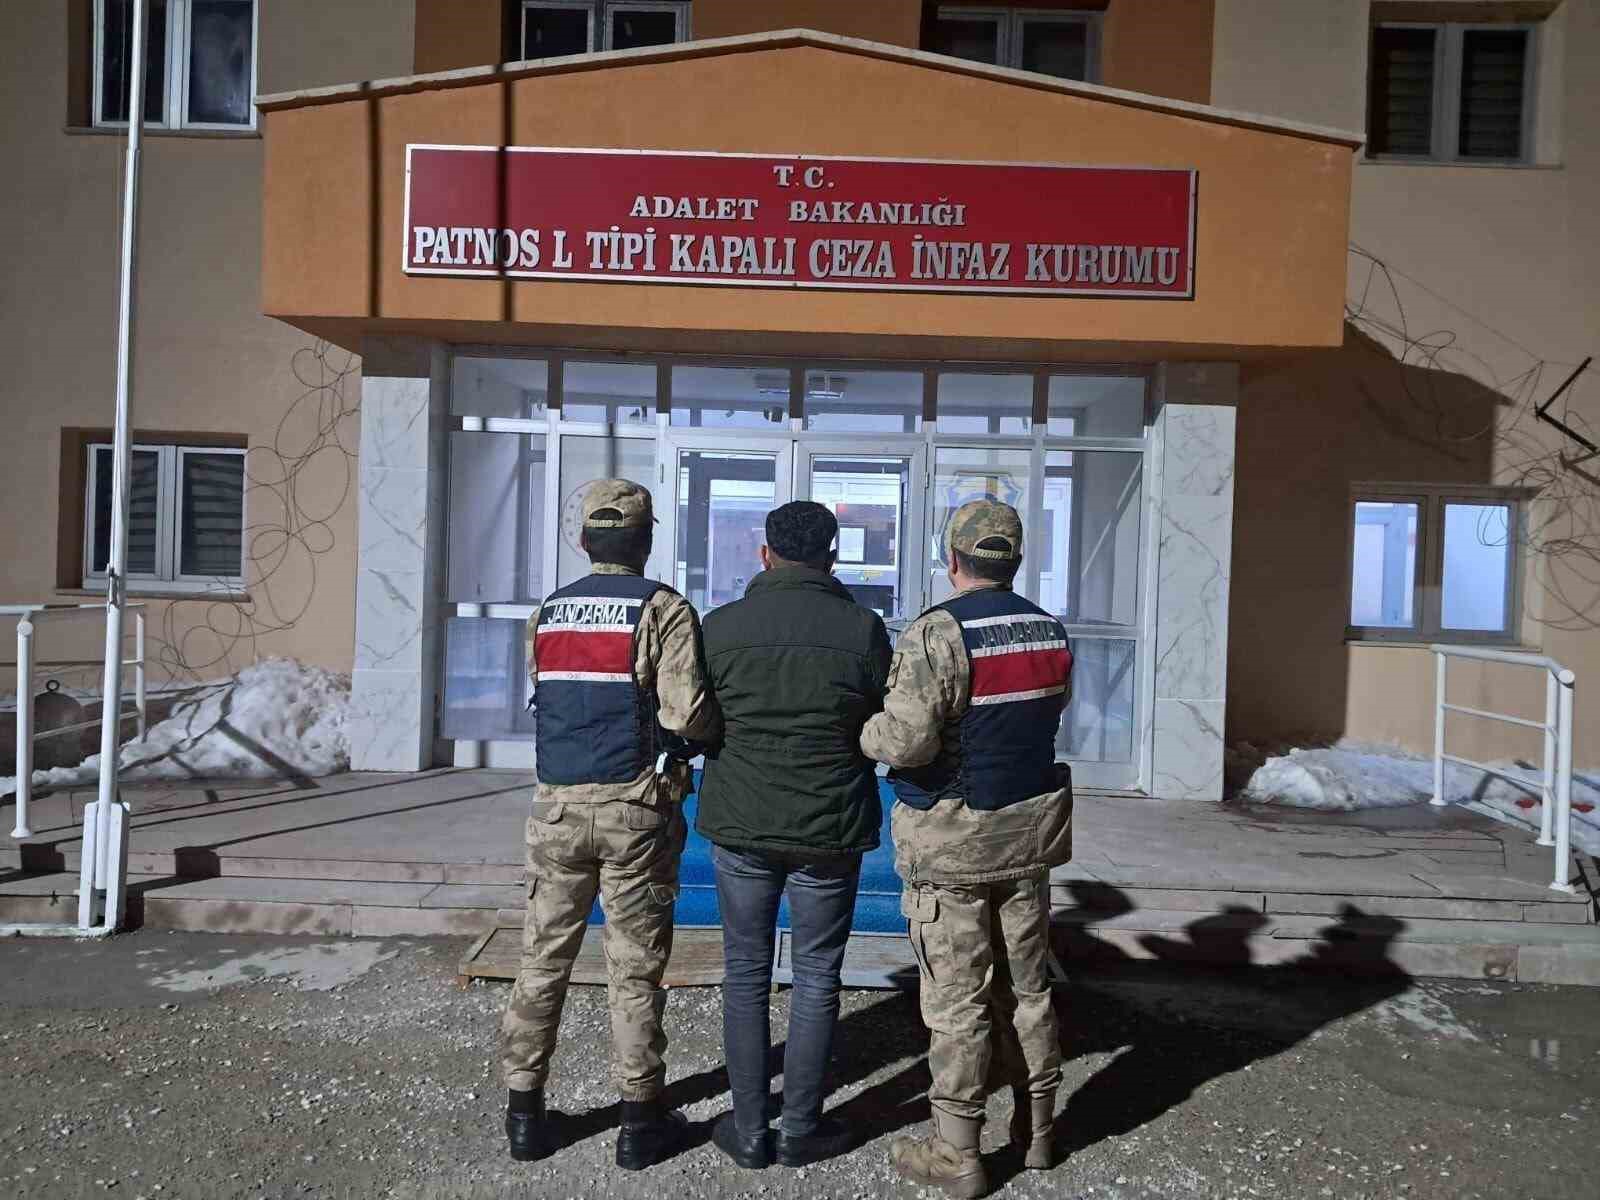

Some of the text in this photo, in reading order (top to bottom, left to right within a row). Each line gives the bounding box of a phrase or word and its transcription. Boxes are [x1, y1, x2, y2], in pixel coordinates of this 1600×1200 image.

[629, 195, 967, 226] ADALET BAKANLIĞI
[412, 225, 1180, 285] PATNOS L TİPİ KAPALI CEZA İNFAZ KURUMU
[547, 603, 627, 625] JANDARMA
